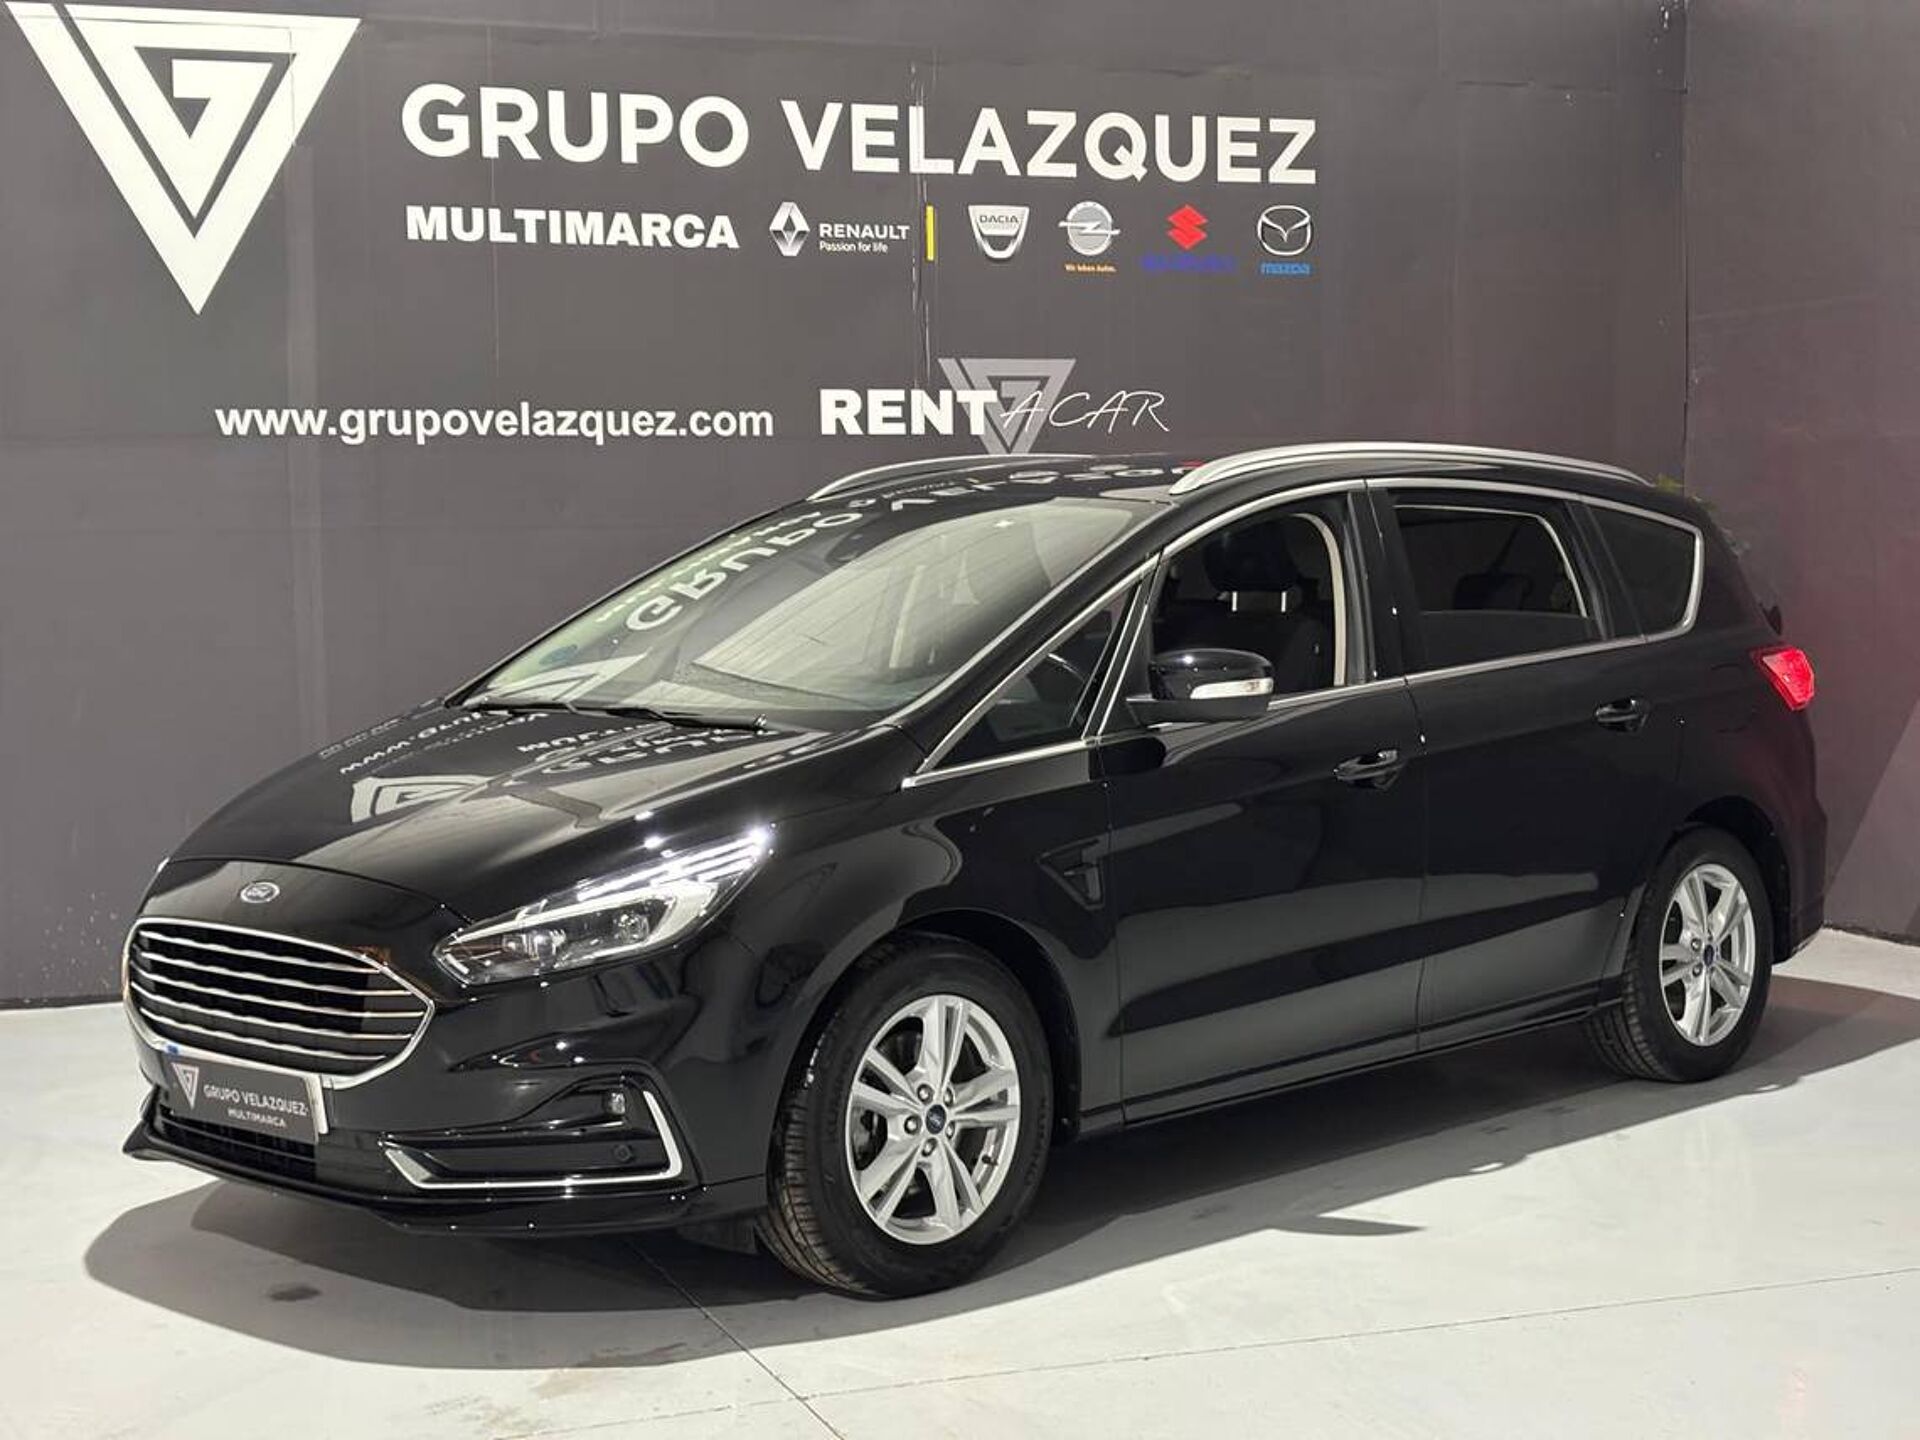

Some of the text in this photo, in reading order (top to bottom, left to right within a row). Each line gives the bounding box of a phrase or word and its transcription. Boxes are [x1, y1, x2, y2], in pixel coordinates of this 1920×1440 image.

[402, 83, 1316, 185] GRUPO VELAZQUEZ
[406, 205, 740, 249] MULTIMARCA
[819, 223, 910, 239] RENAULT
[979, 214, 1019, 223] DACIA
[819, 240, 889, 253] Passion for life
[215, 402, 774, 446] www.grupovelazquez.com
[820, 389, 998, 435] RENT
[203, 1084, 308, 1117] GRUPO VELAZQUEZ
[227, 1107, 287, 1128] MULTIMARCA
